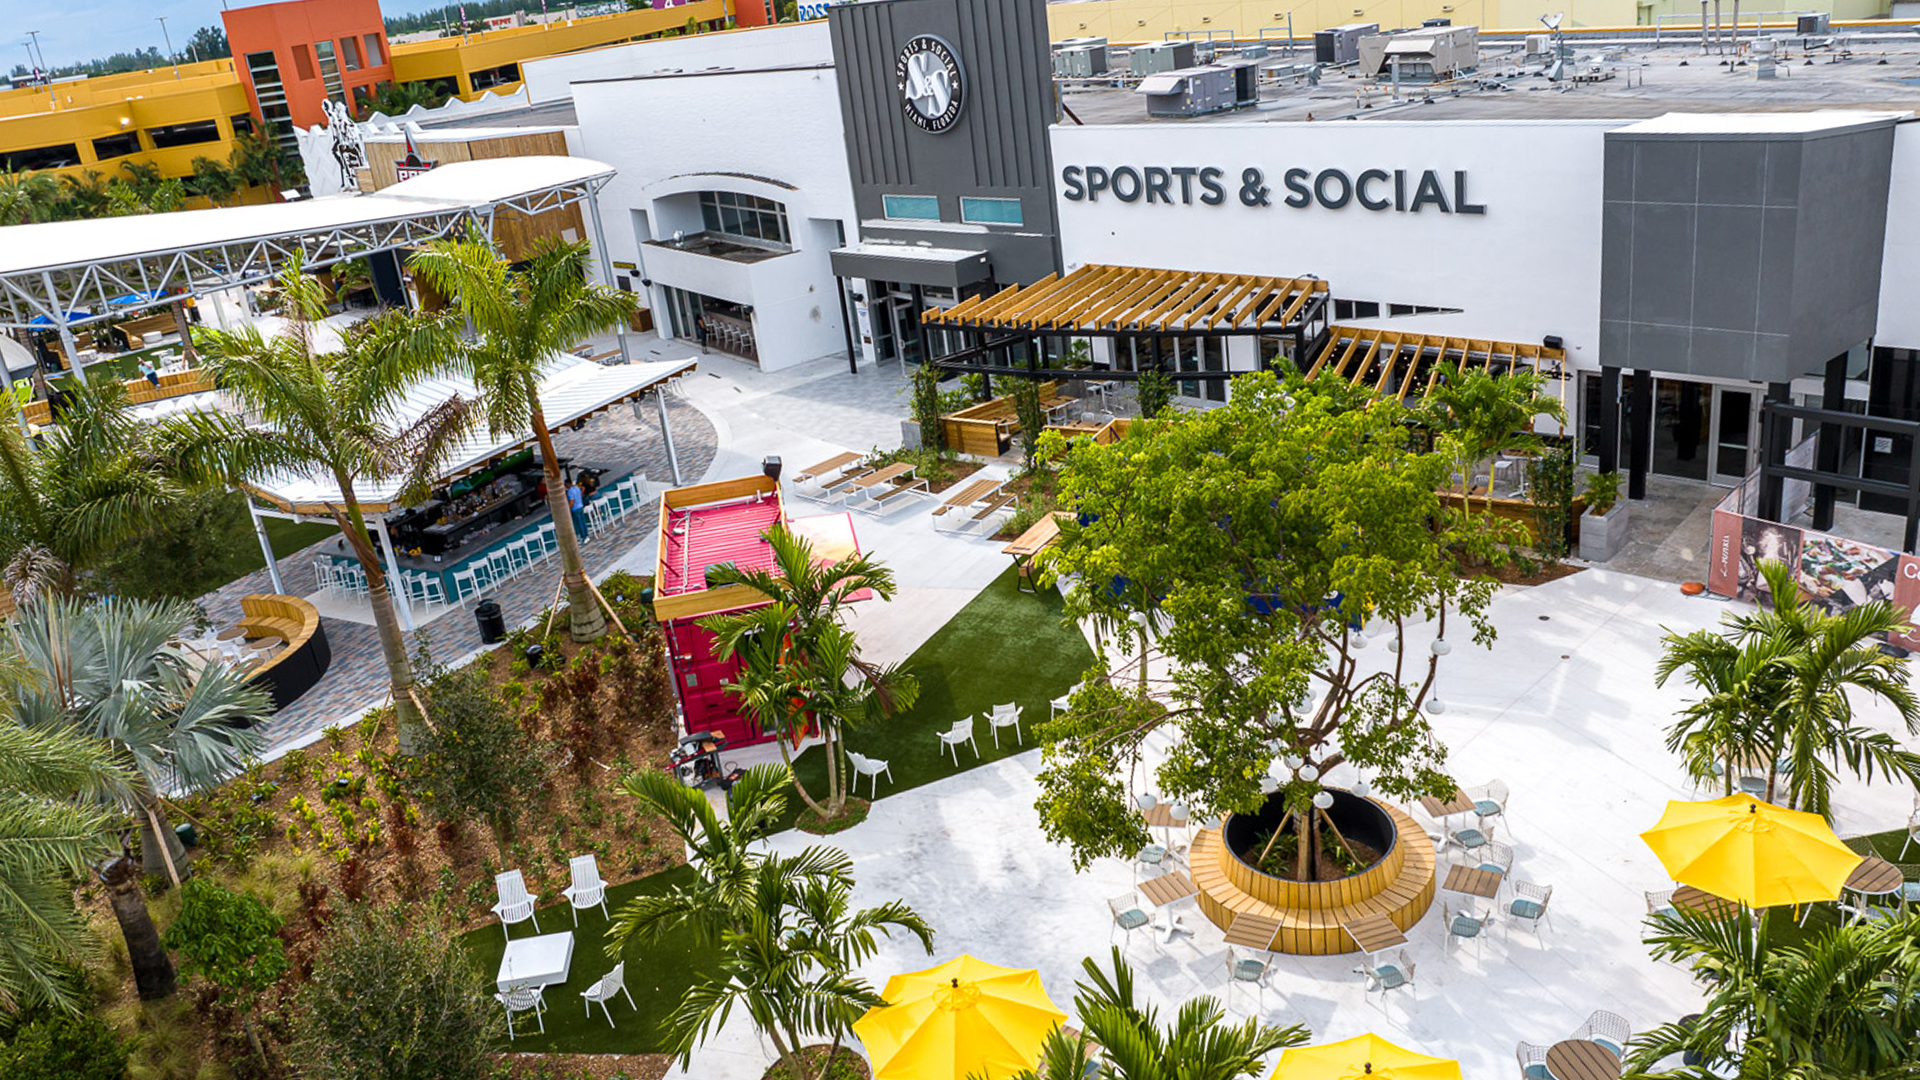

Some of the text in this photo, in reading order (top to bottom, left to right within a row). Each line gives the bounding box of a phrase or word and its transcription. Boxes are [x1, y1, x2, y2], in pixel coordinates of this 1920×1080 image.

[491, 17, 512, 26] DEPOT
[896, 38, 957, 78] SPORTS & SOCIAL
[904, 99, 959, 131] MIAMI, FLORIDA
[1062, 165, 1488, 215] SPORTS & SOCIAL
